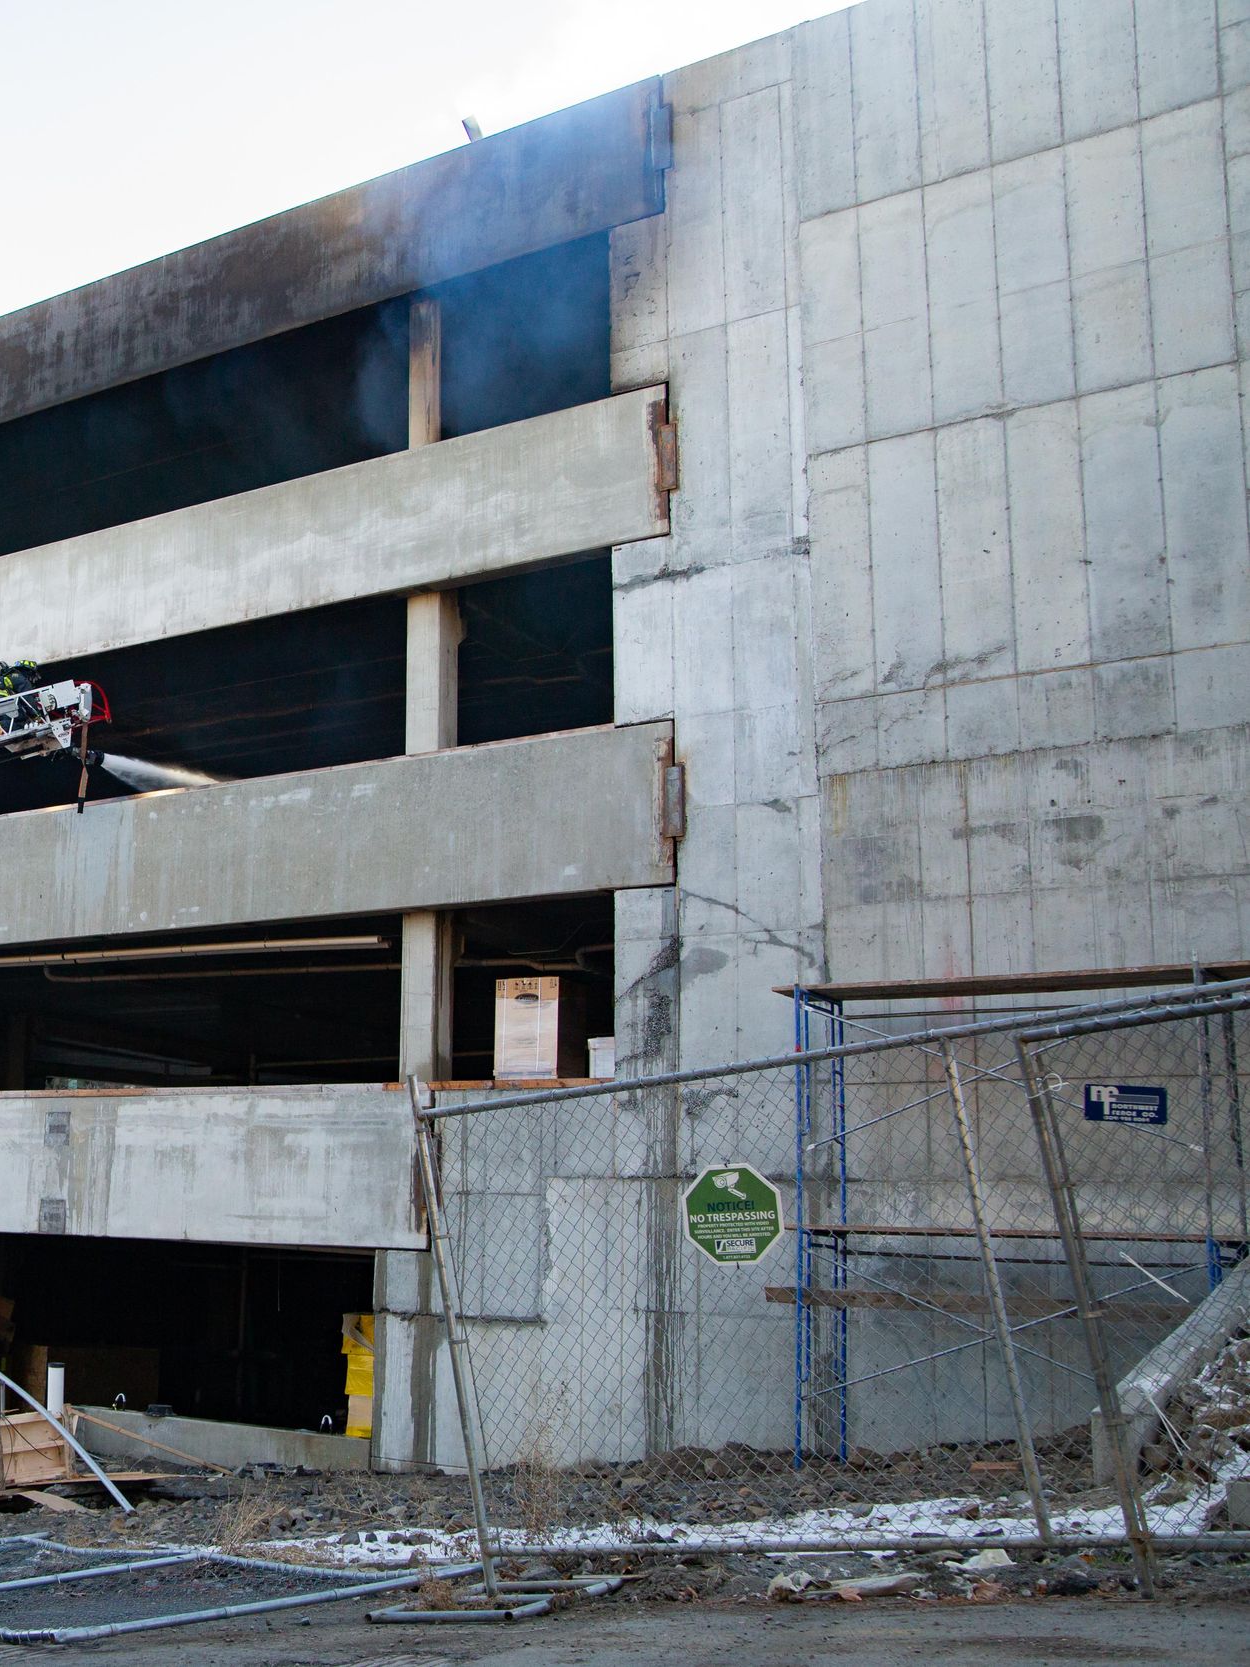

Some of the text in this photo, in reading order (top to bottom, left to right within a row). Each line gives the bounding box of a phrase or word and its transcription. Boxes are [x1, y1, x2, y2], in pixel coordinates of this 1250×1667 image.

[707, 1200, 755, 1212] NOTICE!
[690, 1210, 776, 1223] NO TRESPASSING
[726, 1239, 755, 1247] SECURE
